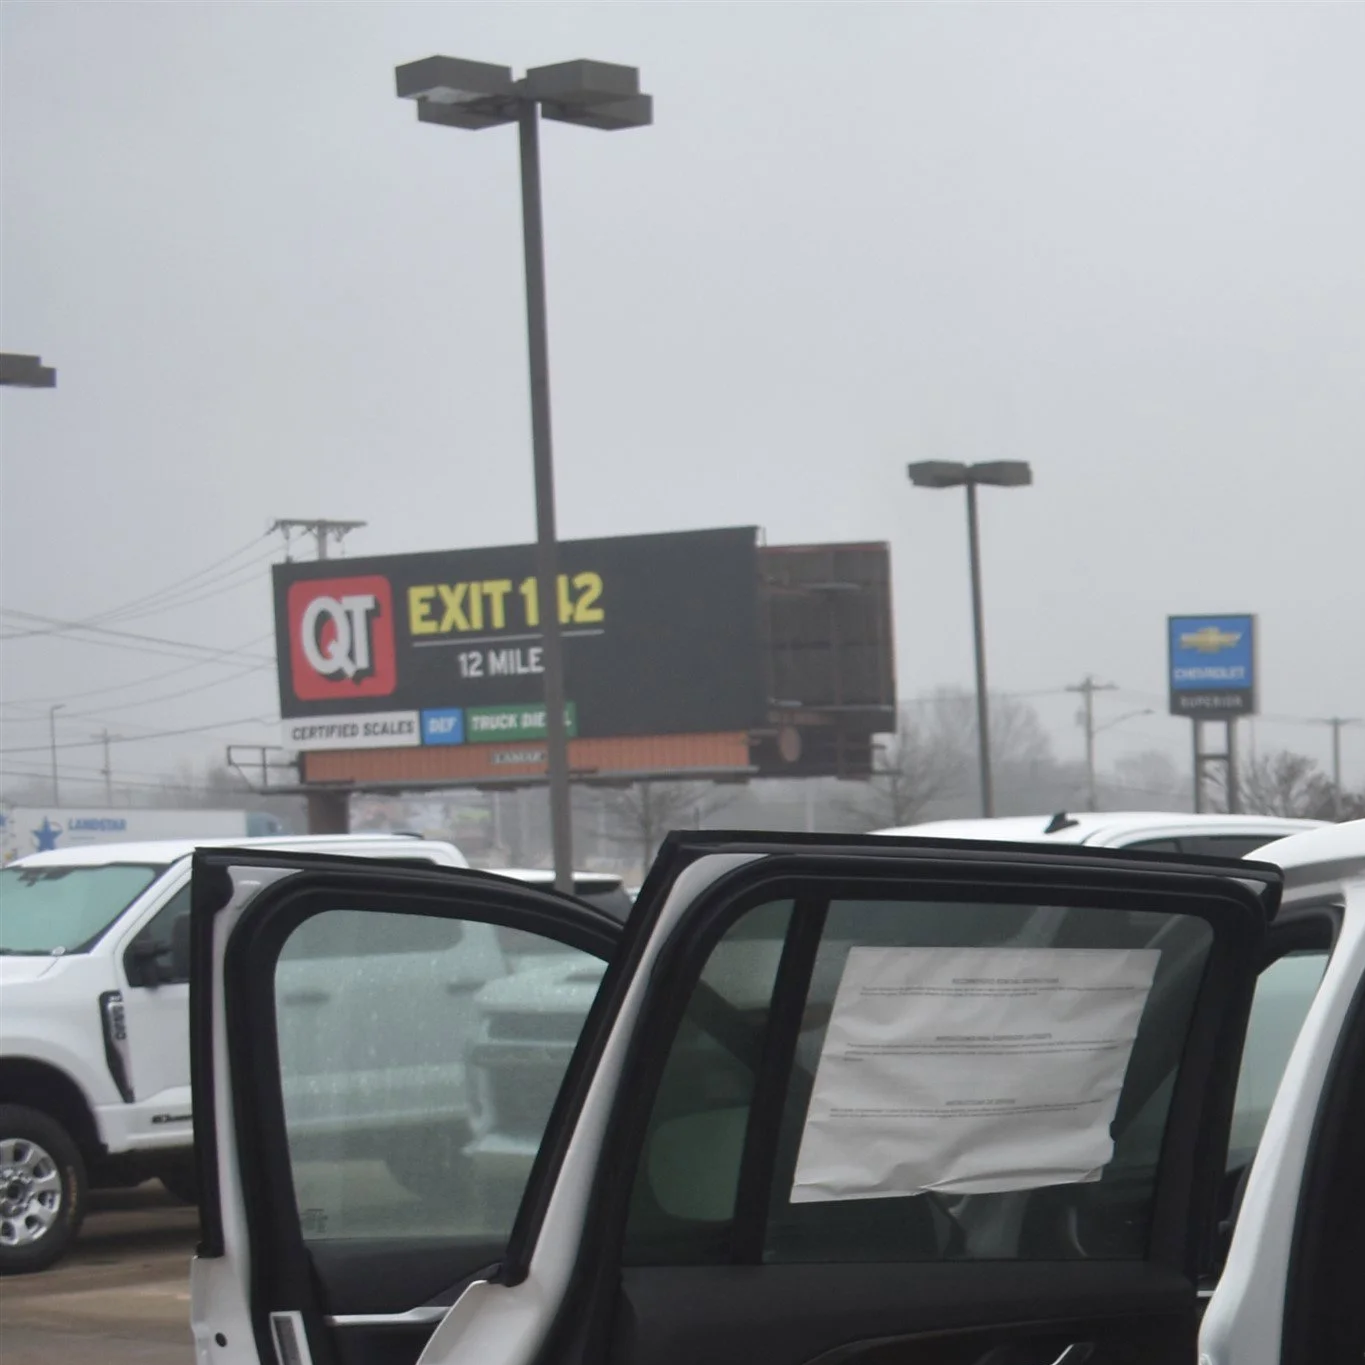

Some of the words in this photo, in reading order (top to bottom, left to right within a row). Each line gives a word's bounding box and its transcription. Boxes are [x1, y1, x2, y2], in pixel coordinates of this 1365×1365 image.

[408, 579, 512, 635] EXIT
[302, 595, 377, 680] QT
[458, 652, 484, 678] 12
[489, 647, 546, 675] MILE
[291, 722, 360, 741] CERTIFIED
[362, 719, 416, 738] SCALES
[471, 712, 517, 731] TRUCK
[520, 709, 573, 730] DIEL
